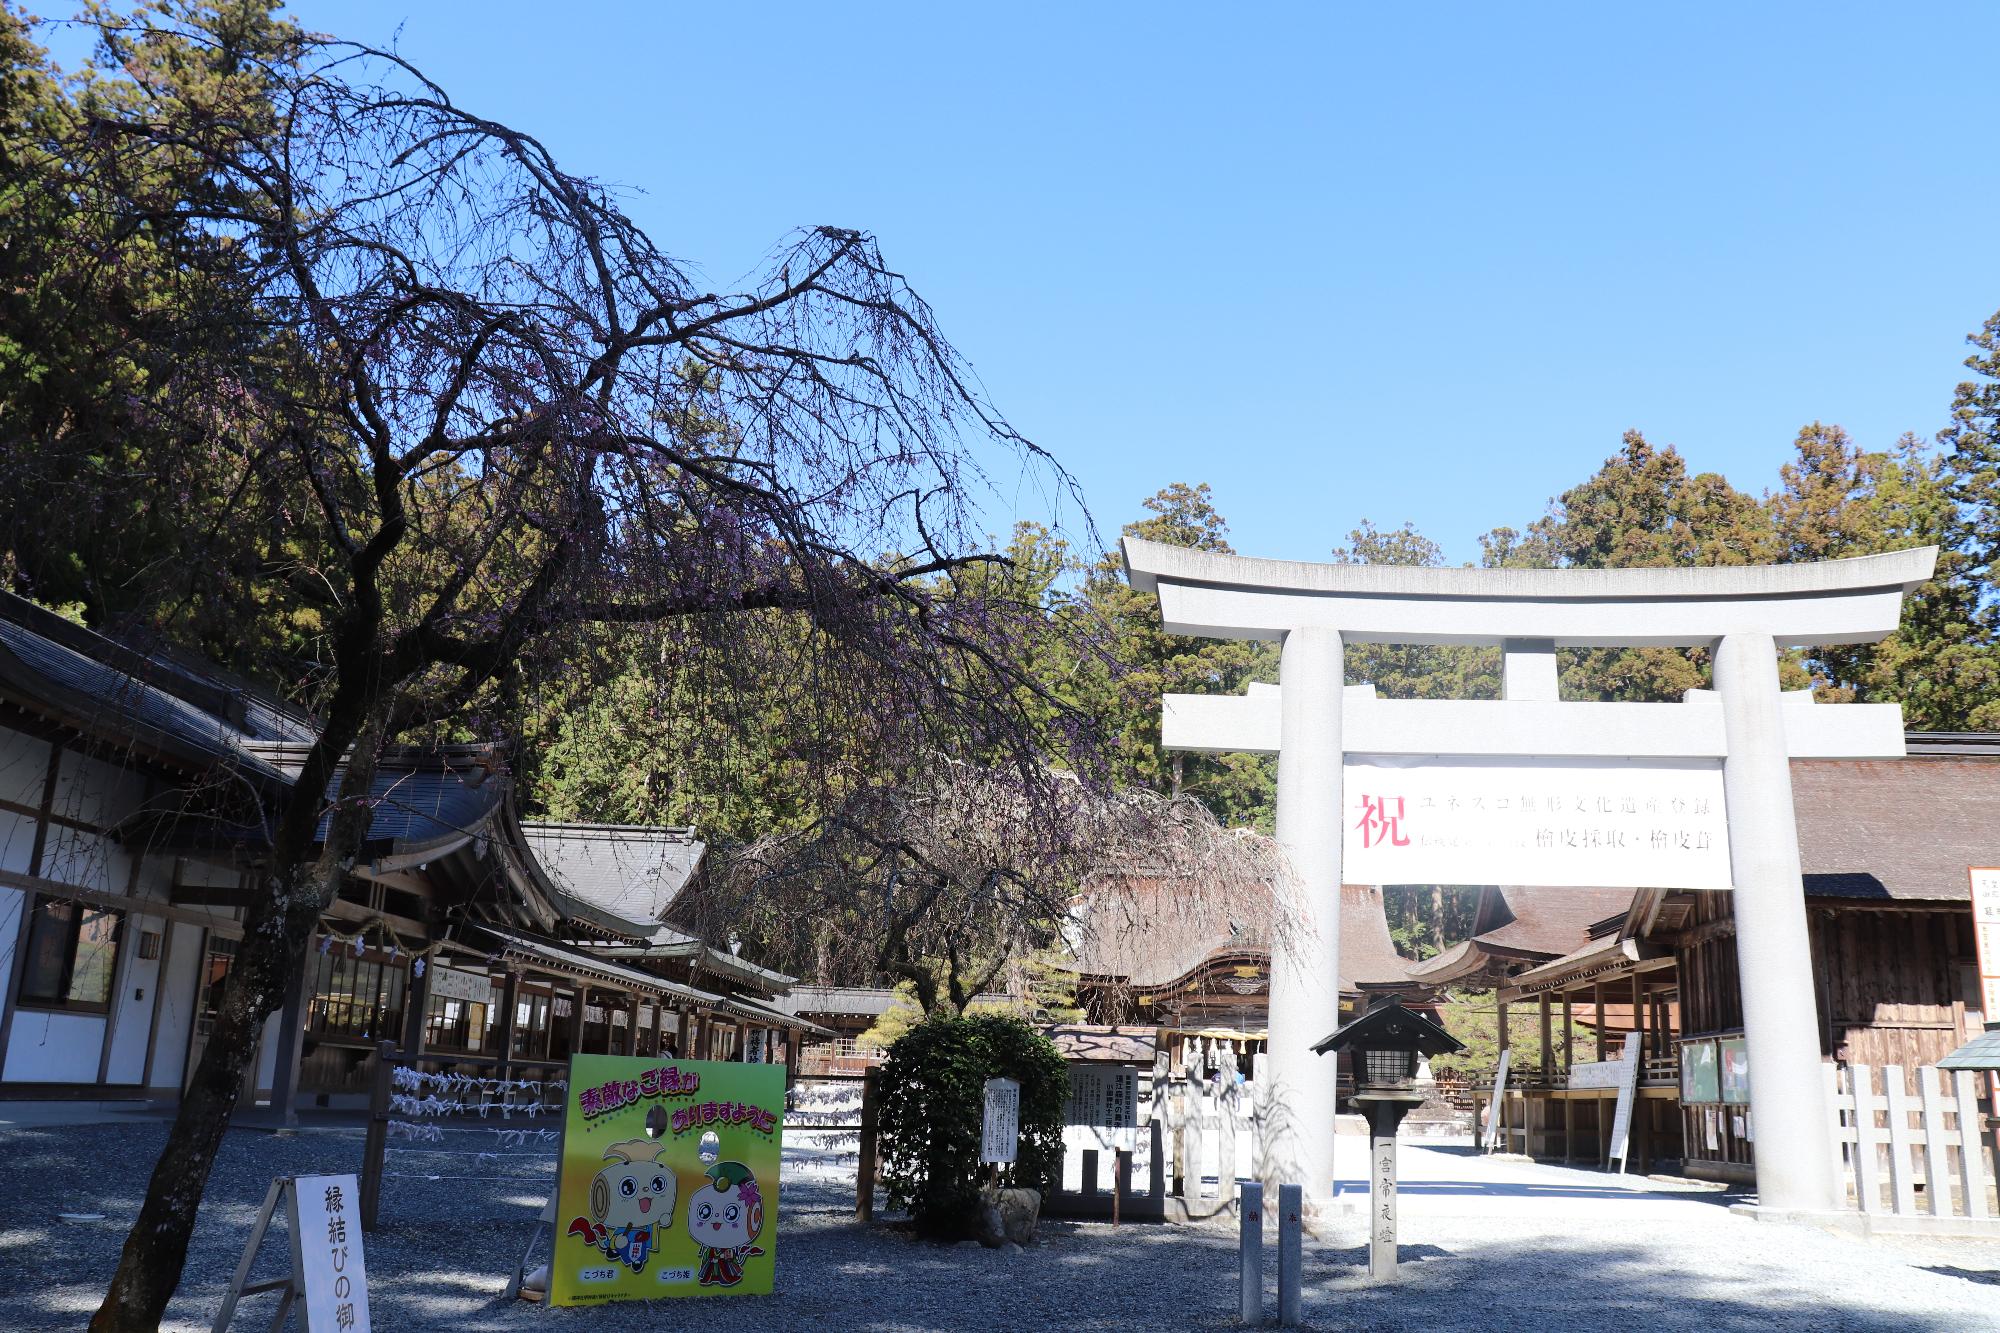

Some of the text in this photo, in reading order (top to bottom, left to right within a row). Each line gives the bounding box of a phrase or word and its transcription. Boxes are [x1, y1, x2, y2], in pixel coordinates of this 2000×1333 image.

[1354, 793, 1411, 849] 祝
[1419, 794, 1711, 815] ユネスコ無形文化遺産登録
[579, 1066, 700, 1121] 素敵なご縁が
[671, 1101, 778, 1135] ありますように
[324, 1186, 354, 1330] 縁結びの御
[583, 1269, 615, 1281] こづち君
[661, 1270, 691, 1281] こづち姫
